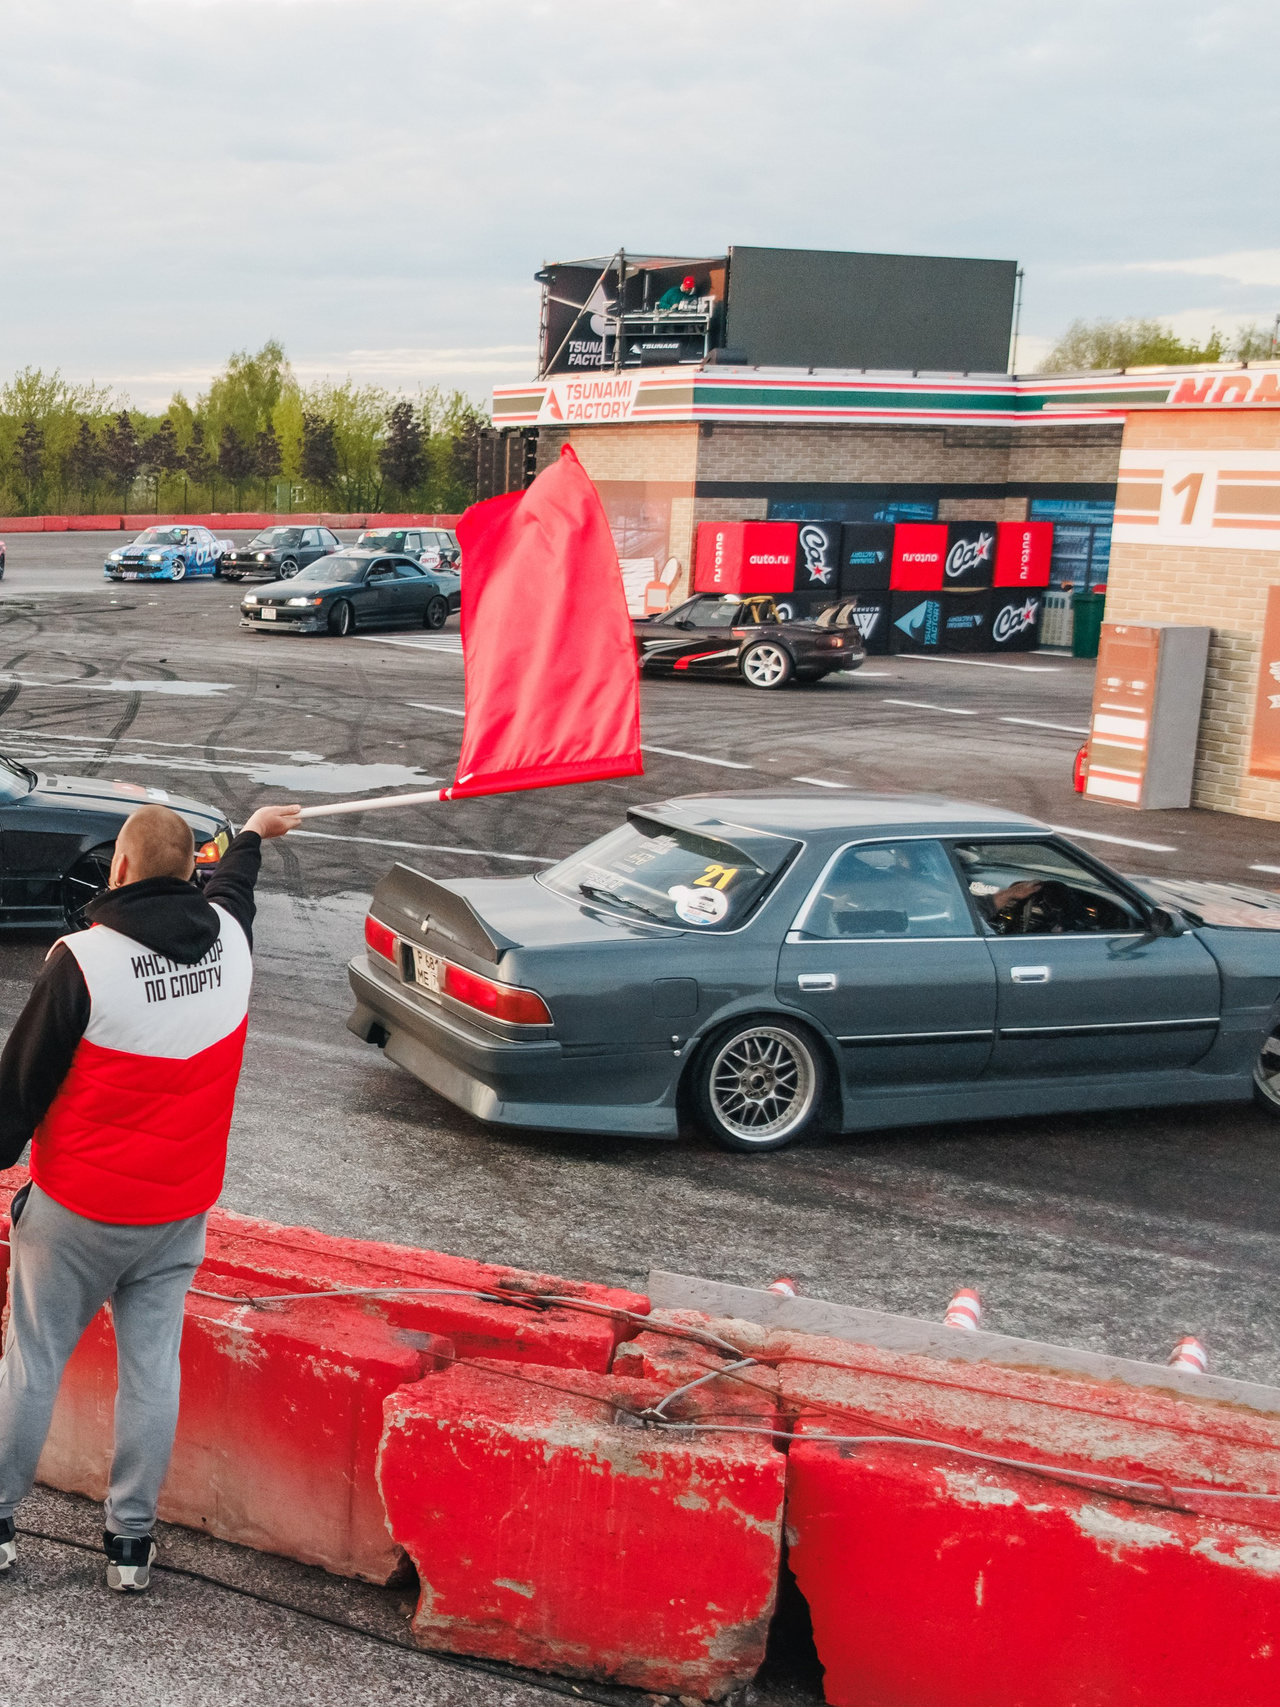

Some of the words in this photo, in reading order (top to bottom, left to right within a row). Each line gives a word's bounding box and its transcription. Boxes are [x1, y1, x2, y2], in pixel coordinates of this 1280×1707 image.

[566, 380, 632, 400] TSUNAMI
[566, 400, 633, 420] FACTORY
[1171, 472, 1204, 525] 1
[714, 532, 724, 583] auto.ru
[749, 554, 790, 565] auto.ru
[902, 553, 939, 563] auto.ru
[1020, 531, 1032, 580] auto.ru
[924, 600, 934, 645] TSUNAMI
[930, 601, 940, 645] FACTORY
[692, 864, 738, 891] 21
[144, 979, 167, 1003] ПО
[170, 965, 221, 998] СПОРТУ
